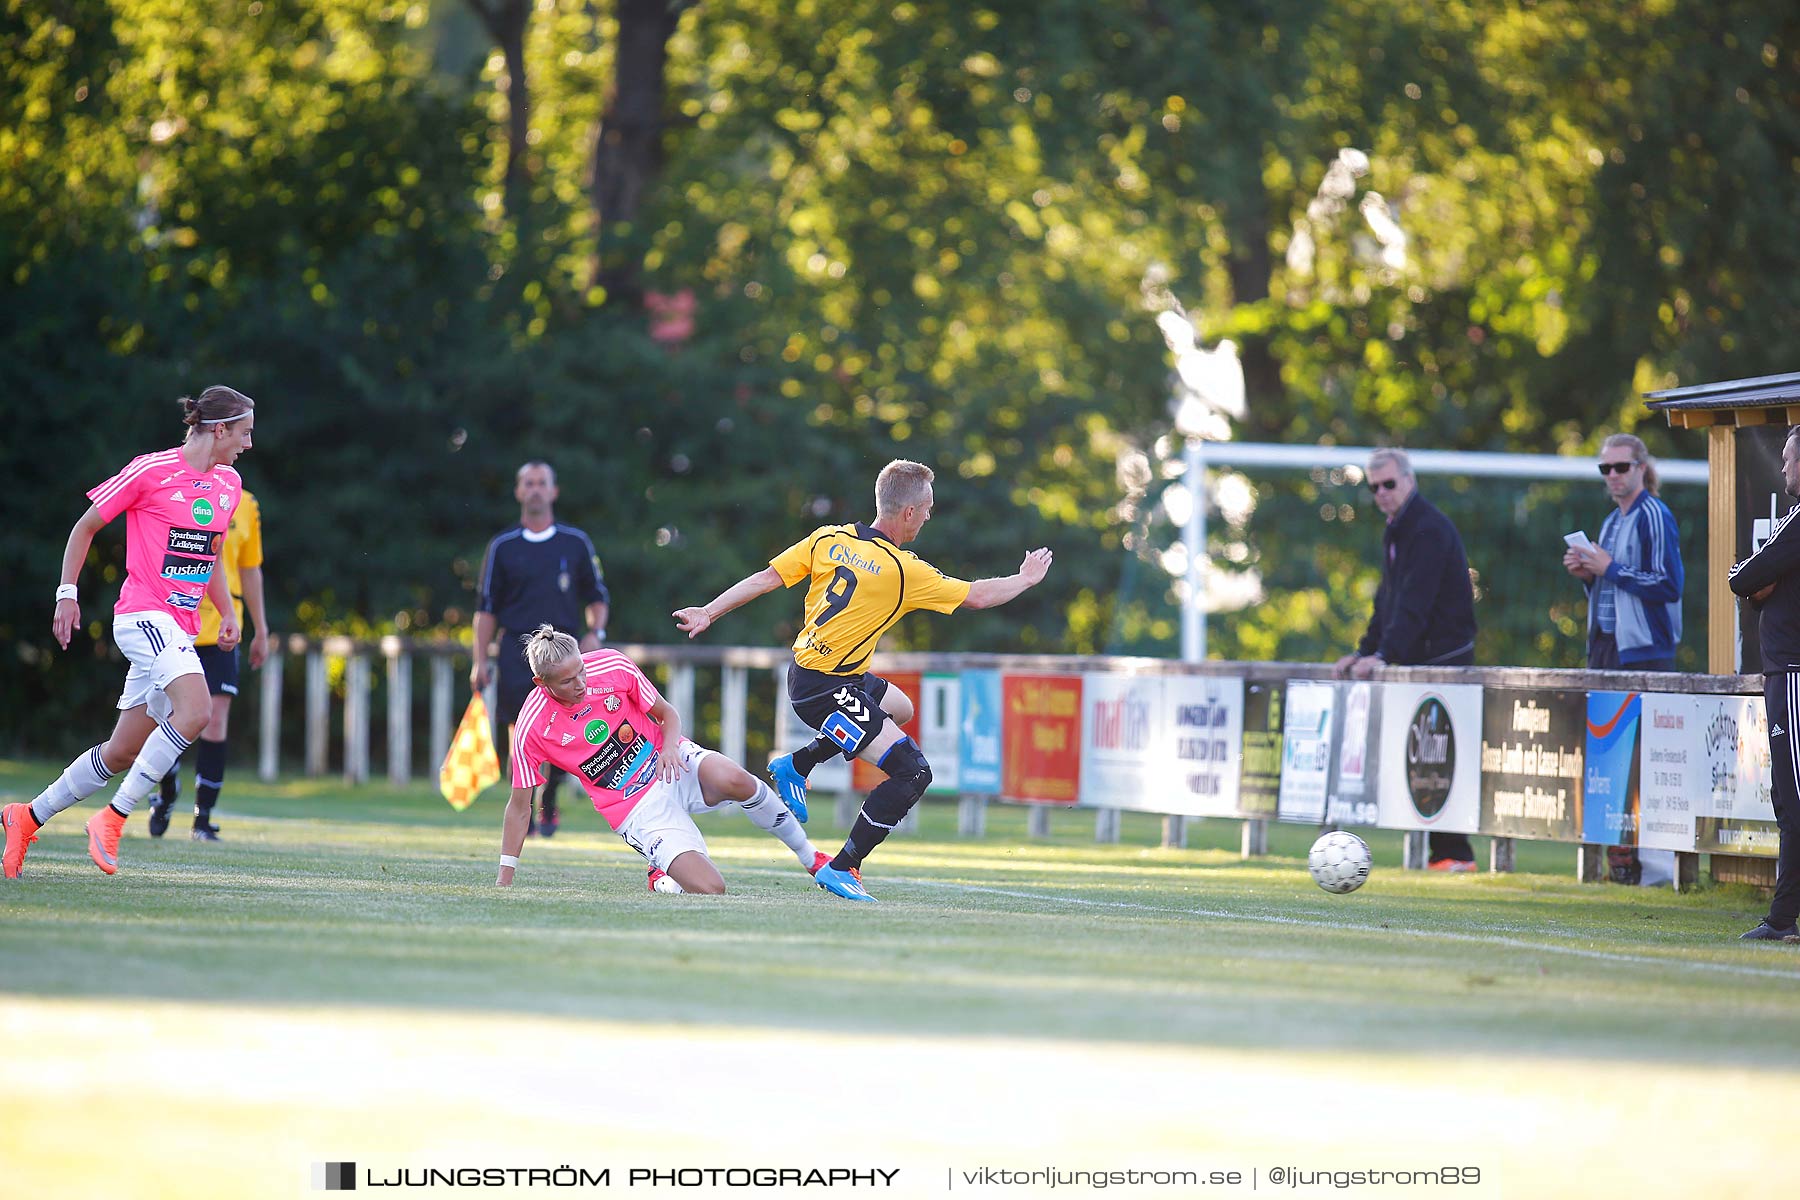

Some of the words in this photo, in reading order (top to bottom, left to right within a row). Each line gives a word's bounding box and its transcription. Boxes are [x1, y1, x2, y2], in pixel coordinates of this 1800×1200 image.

[193, 506, 212, 516] dina
[169, 529, 208, 542] Sparbanken
[169, 540, 205, 552] Lidköping
[164, 562, 207, 578] gustafe
[814, 565, 858, 628] 9
[588, 724, 607, 741] dina
[631, 735, 645, 758] bil
[581, 741, 615, 773] Sparbanken
[588, 749, 619, 778] Lidköping
